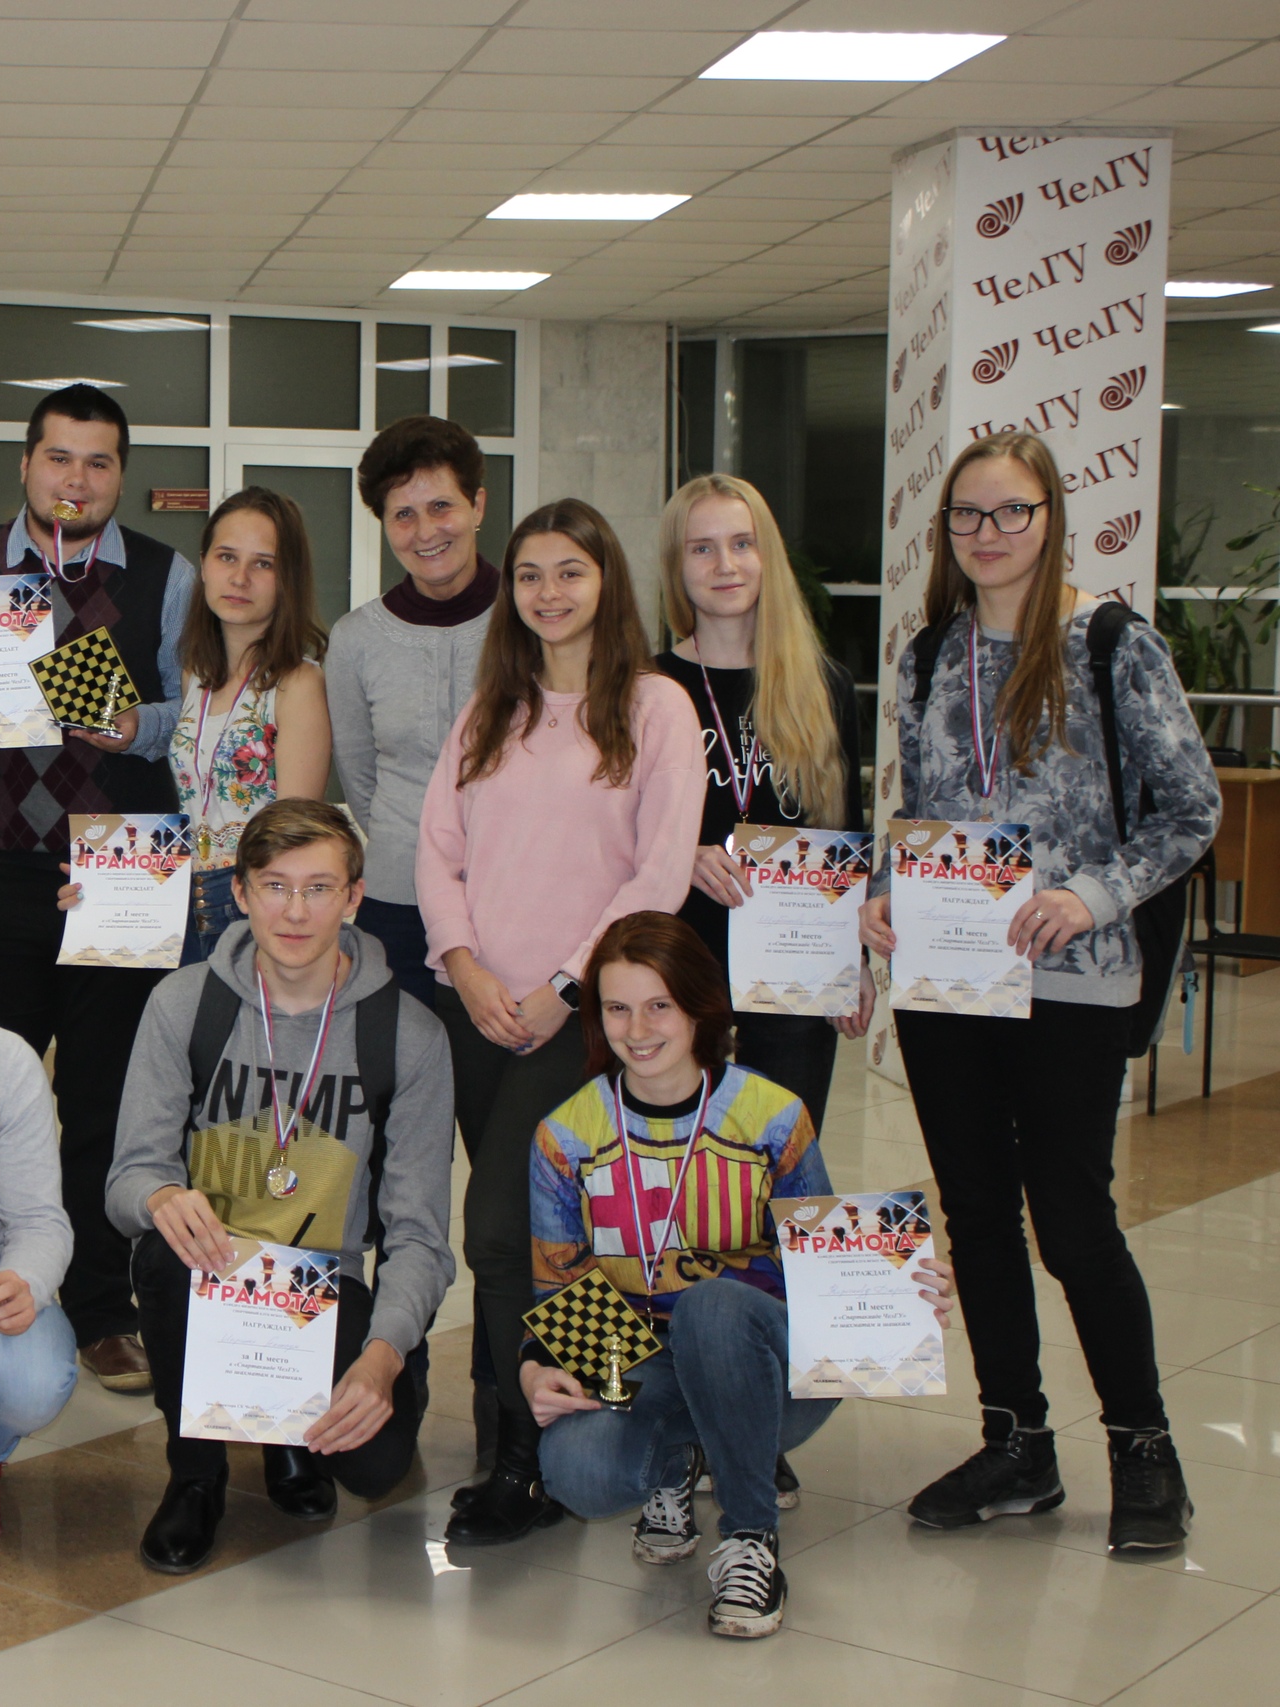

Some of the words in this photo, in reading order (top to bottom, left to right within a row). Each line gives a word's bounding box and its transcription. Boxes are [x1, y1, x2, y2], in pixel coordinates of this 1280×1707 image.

[1039, 147, 1153, 211] ЧелГУ
[894, 250, 929, 319] ЧелГУ
[972, 243, 1087, 306] ЧелГУ
[911, 291, 948, 360] ЧелГУ
[1033, 292, 1147, 356] ЧелГУ
[890, 390, 924, 454] ЧелГУ
[908, 435, 943, 500] ЧелГУ
[1061, 438, 1141, 494] елГУ
[887, 531, 921, 591] ЧелГУ
[902, 606, 926, 638] Чел
[84, 855, 177, 869] ГРАМОТА
[746, 868, 850, 887] ГРАМОТА
[906, 862, 1015, 883] ГРАМОТА
[790, 931, 798, 939] II
[954, 927, 963, 935] II
[798, 1232, 915, 1253] ГРАМОТА
[207, 1283, 320, 1313] ГРАМОТА
[858, 1302, 866, 1310] II
[242, 1321, 292, 1332] НАГРАЖДАЕТ
[254, 1353, 262, 1361] II
